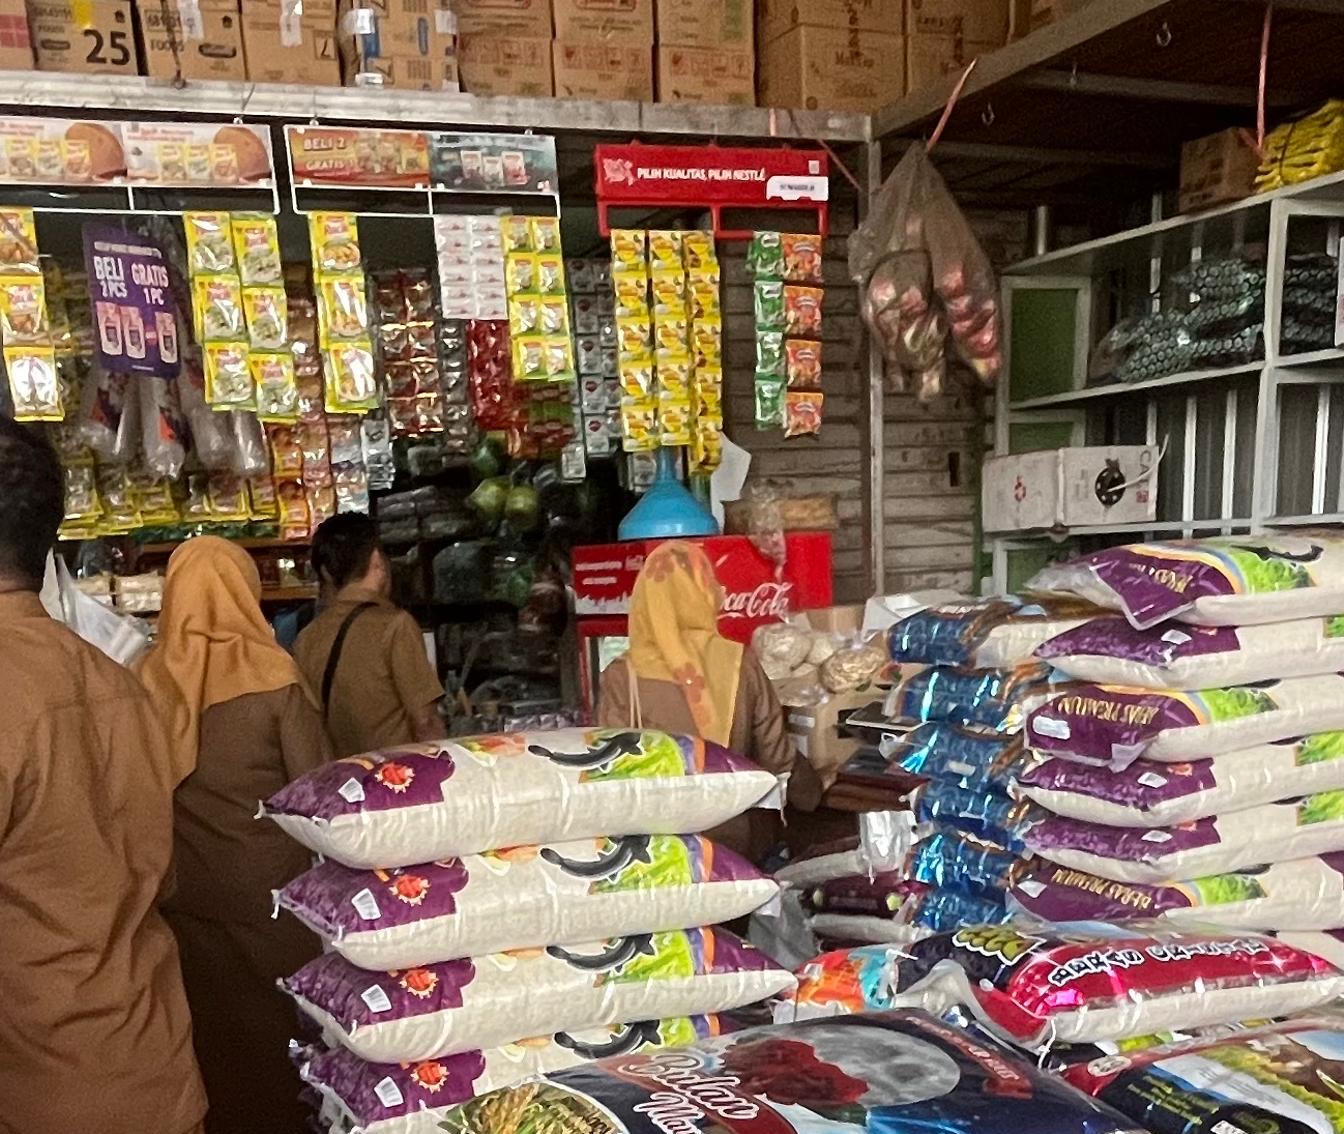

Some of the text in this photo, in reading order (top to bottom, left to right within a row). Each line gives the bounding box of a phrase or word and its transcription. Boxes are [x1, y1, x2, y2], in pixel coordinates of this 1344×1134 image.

[83, 29, 131, 66] 25
[93, 256, 125, 282] BELI
[131, 262, 170, 288] GRATIS
[716, 581, 794, 619] ca-Cola
[1047, 948, 1145, 988] BERAS
[618, 1052, 760, 1121] Bulan
